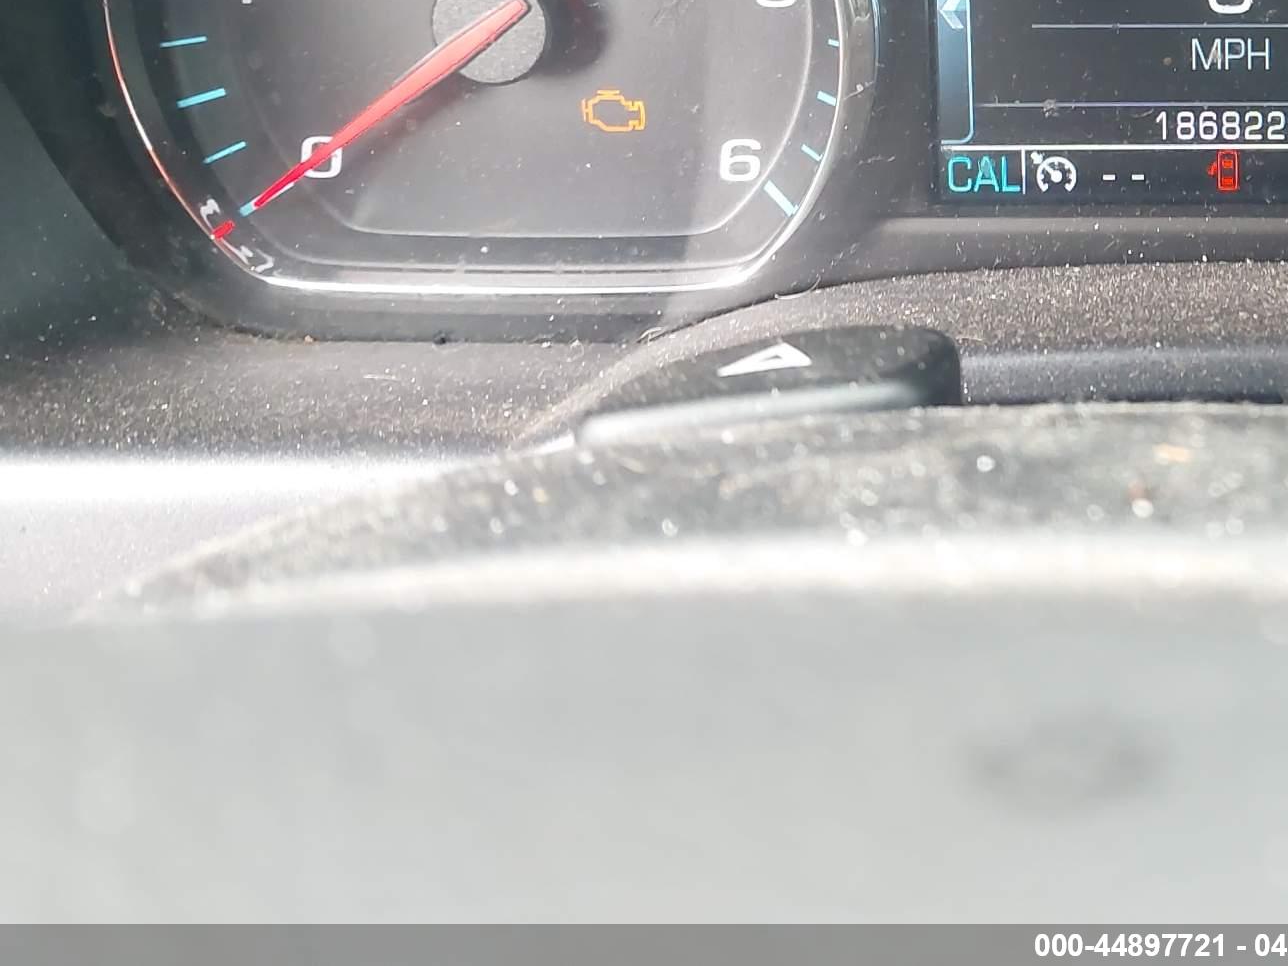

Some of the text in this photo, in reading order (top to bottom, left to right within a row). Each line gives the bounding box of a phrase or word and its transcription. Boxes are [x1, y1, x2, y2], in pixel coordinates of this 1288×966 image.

[1191, 37, 1270, 71] MPH
[1155, 110, 1286, 141] 186822
[301, 135, 343, 179] 0
[719, 138, 761, 182] 6
[947, 155, 1021, 193] CAL
